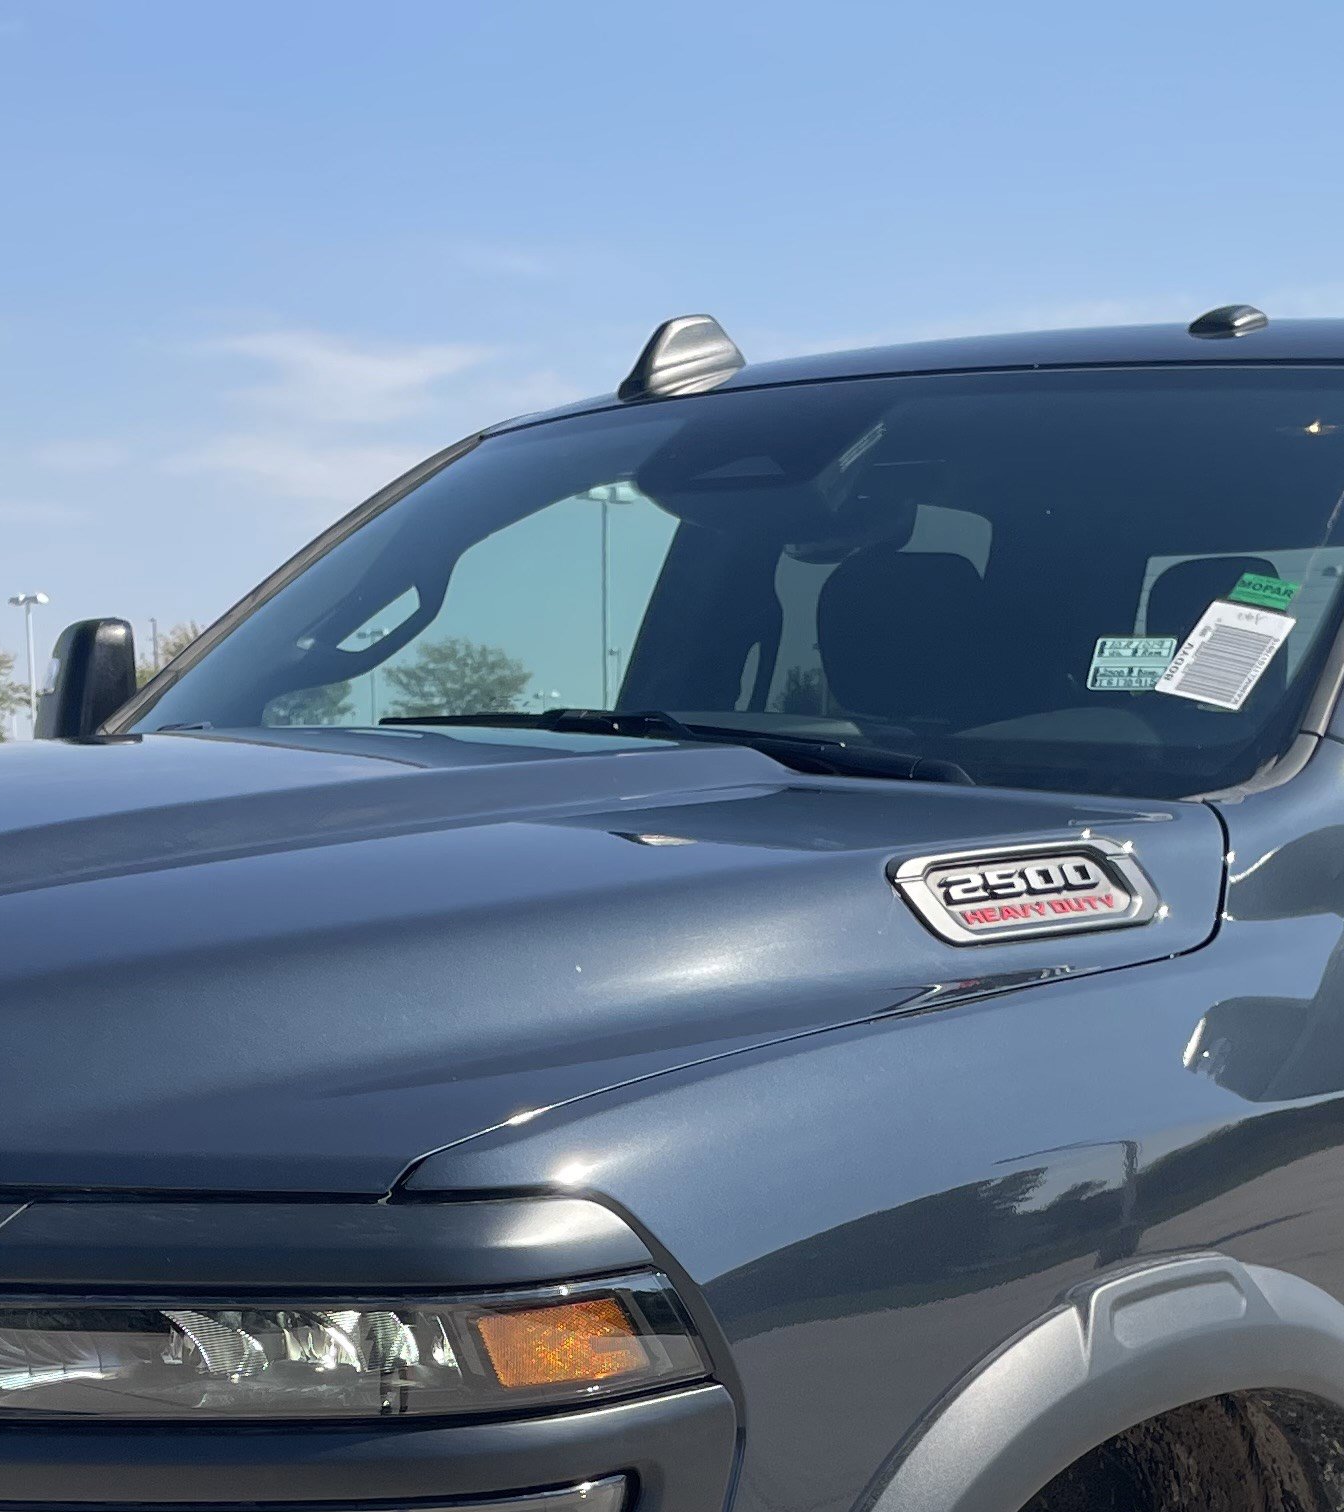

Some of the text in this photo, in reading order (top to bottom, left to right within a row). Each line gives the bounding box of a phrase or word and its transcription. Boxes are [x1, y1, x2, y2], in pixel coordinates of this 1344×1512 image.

[938, 861, 1101, 906] 2500
[959, 893, 1114, 925] HEAVY DUTY
